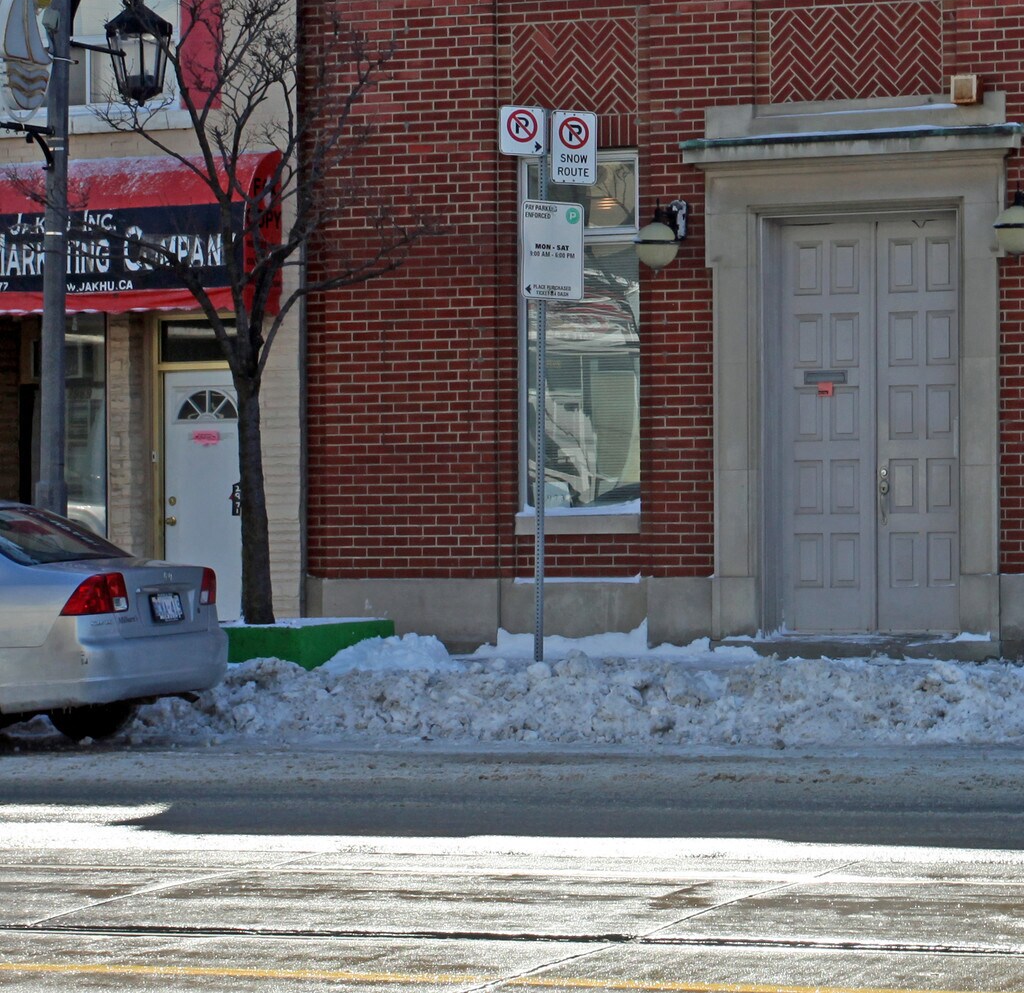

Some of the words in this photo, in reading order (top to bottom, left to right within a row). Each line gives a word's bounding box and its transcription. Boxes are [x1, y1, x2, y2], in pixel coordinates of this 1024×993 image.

[560, 153, 588, 164] SNOW
[557, 167, 590, 178] ROUTE
[0, 234, 110, 276] ARKTING
[123, 225, 236, 272] CMPAN
